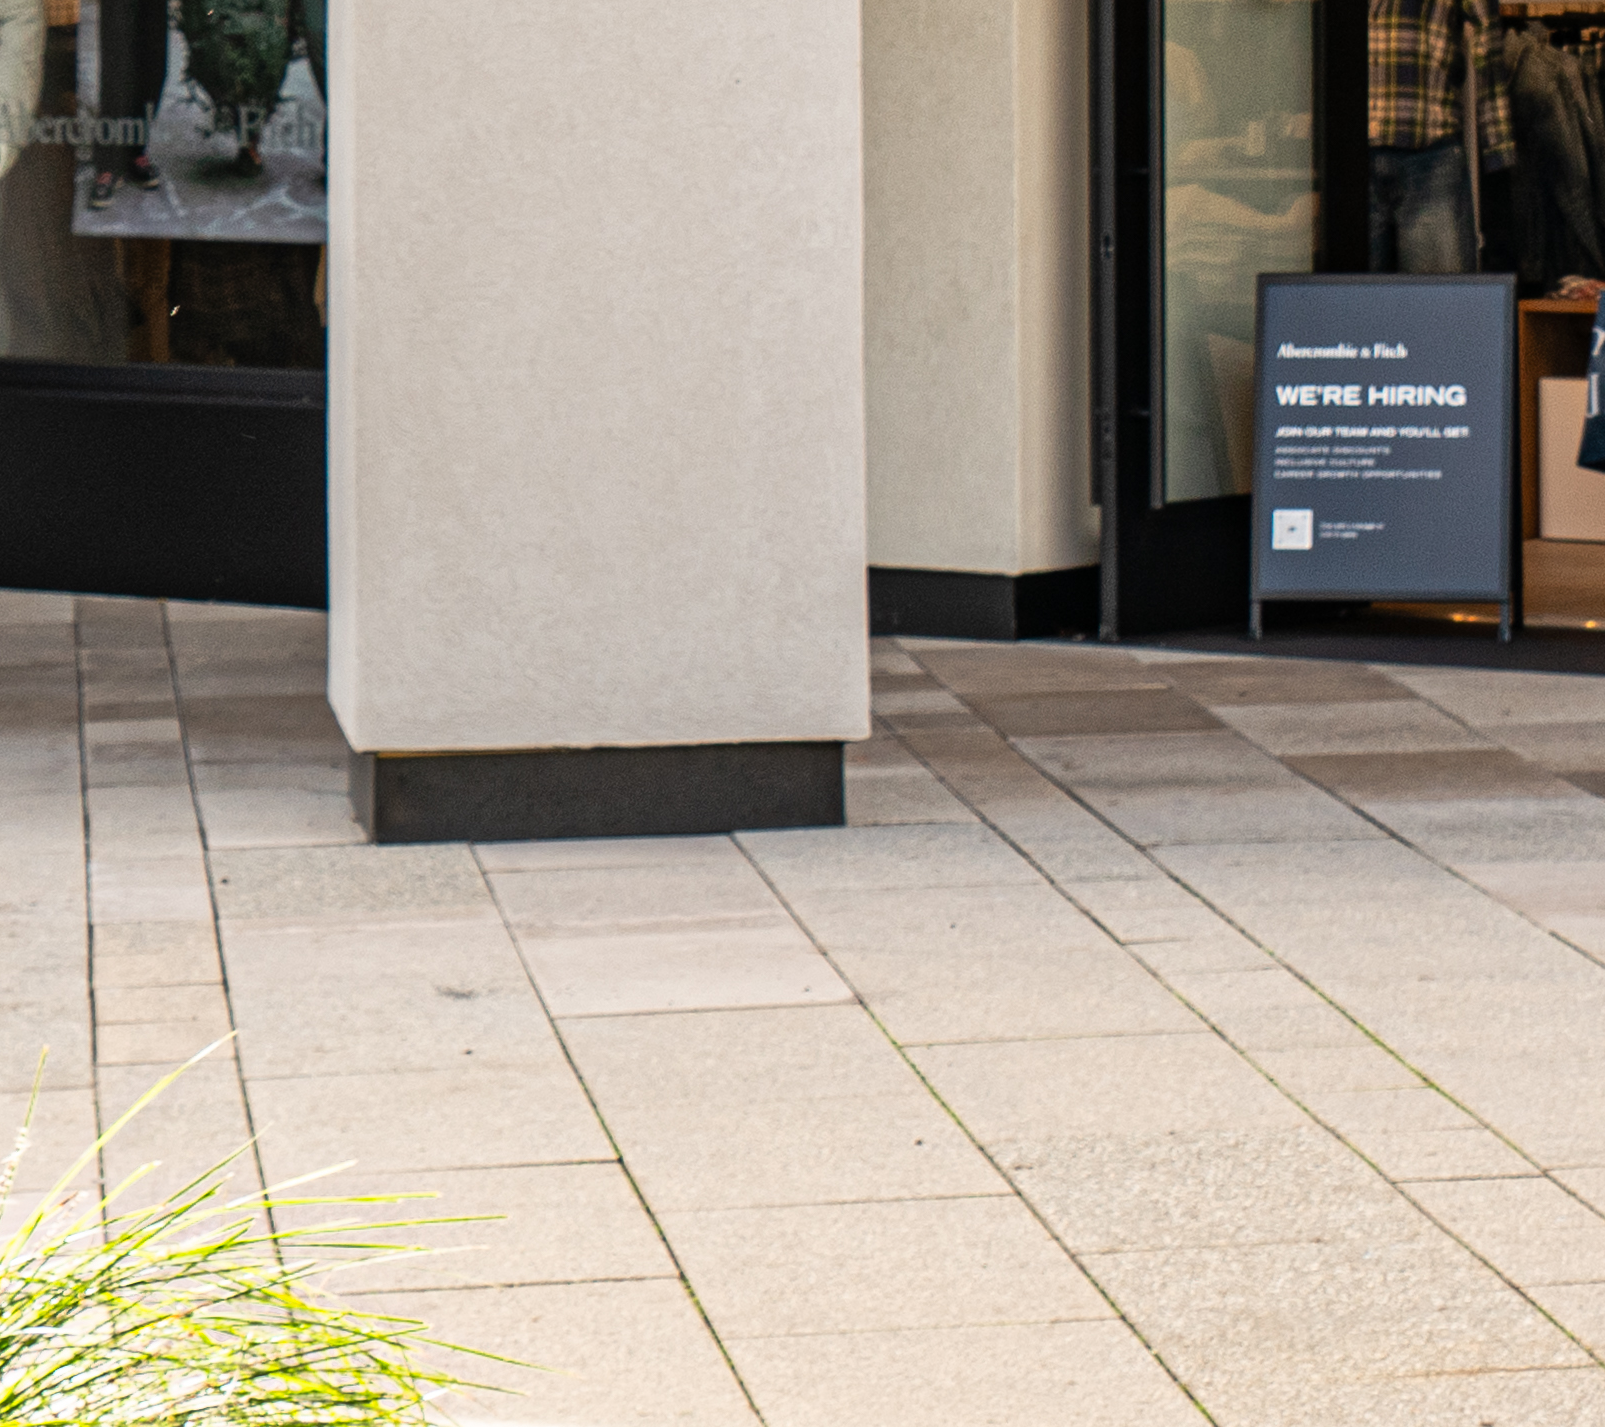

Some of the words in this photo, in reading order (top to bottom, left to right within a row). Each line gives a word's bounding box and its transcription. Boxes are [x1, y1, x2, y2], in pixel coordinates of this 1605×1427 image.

[1276, 343, 1358, 359] Abercrombie
[1373, 343, 1408, 359] Fitch
[1276, 385, 1362, 406] WE'RE
[1368, 385, 1467, 406] HIRING
[1304, 426, 1333, 438] OUR
[1335, 426, 1369, 438] TEAM
[1369, 426, 1397, 438] AND
